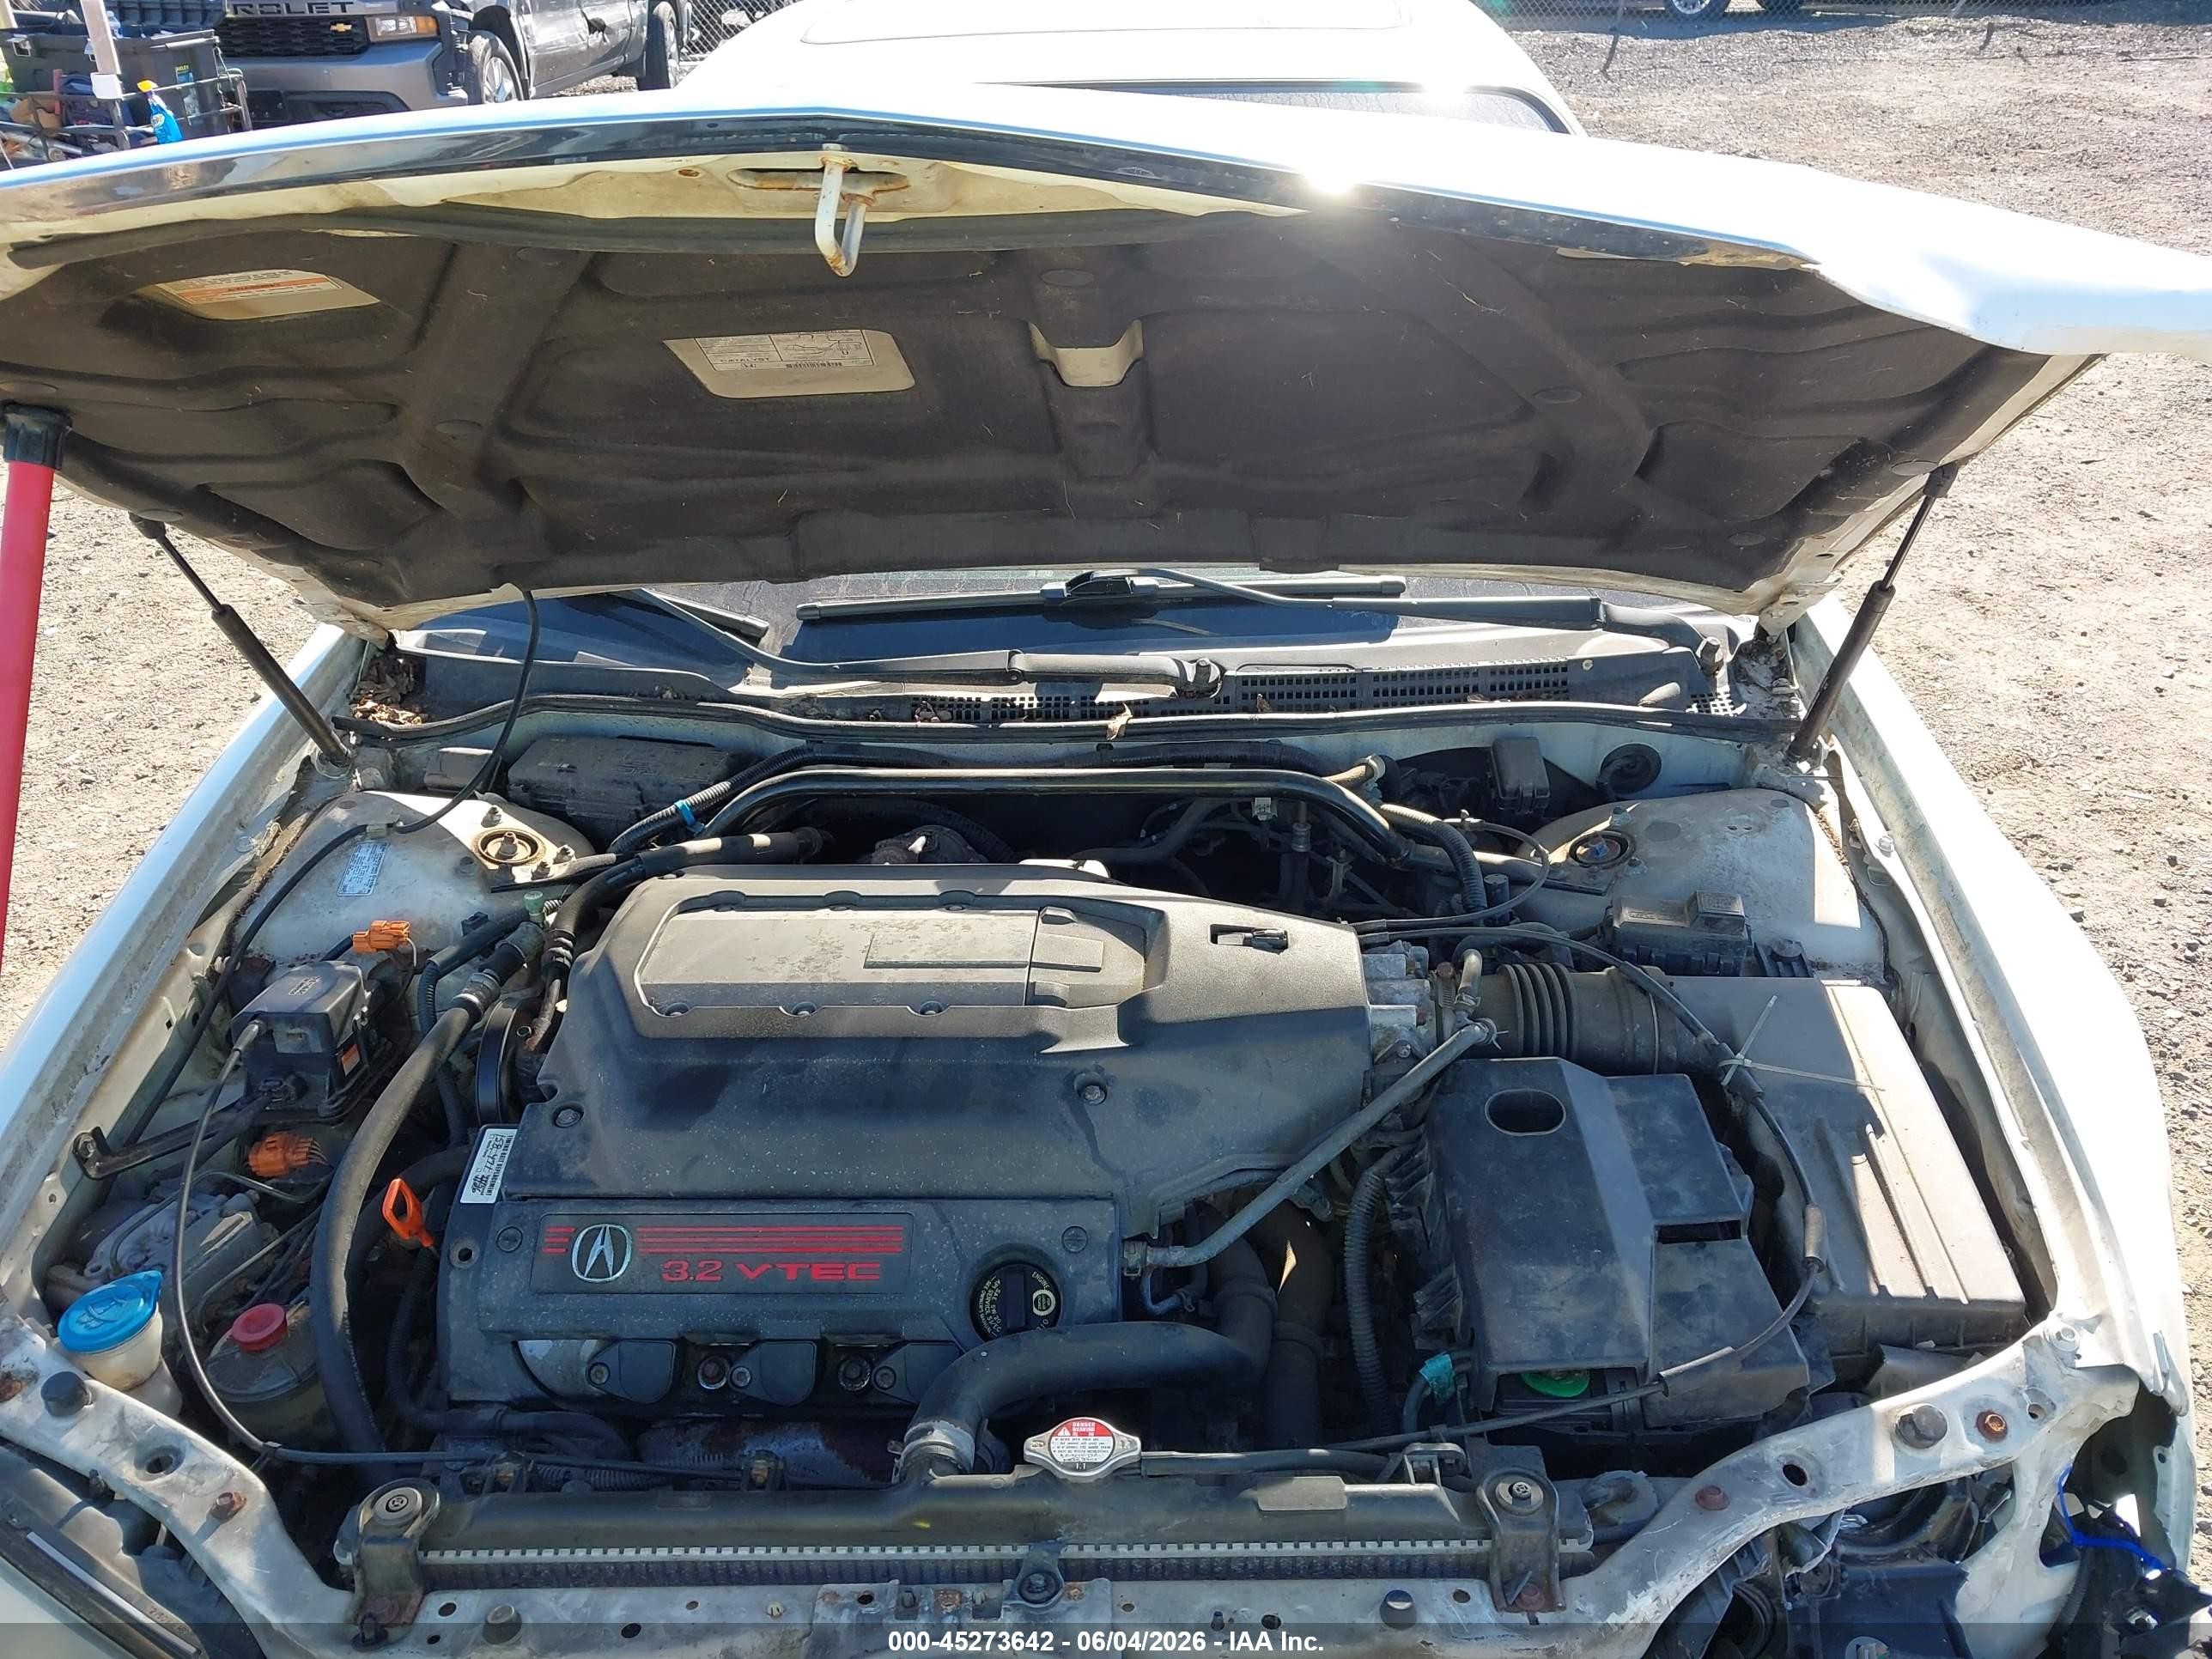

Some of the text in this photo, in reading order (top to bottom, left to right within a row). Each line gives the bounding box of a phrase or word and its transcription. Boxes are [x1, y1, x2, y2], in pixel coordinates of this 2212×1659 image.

[232, 2, 354, 15] ROLET
[503, 1135, 513, 1151] TIMING
[498, 1152, 506, 1162] BELT
[662, 1261, 879, 1282] 3.2 VTEC
[1031, 1271, 1050, 1289] ENGINE
